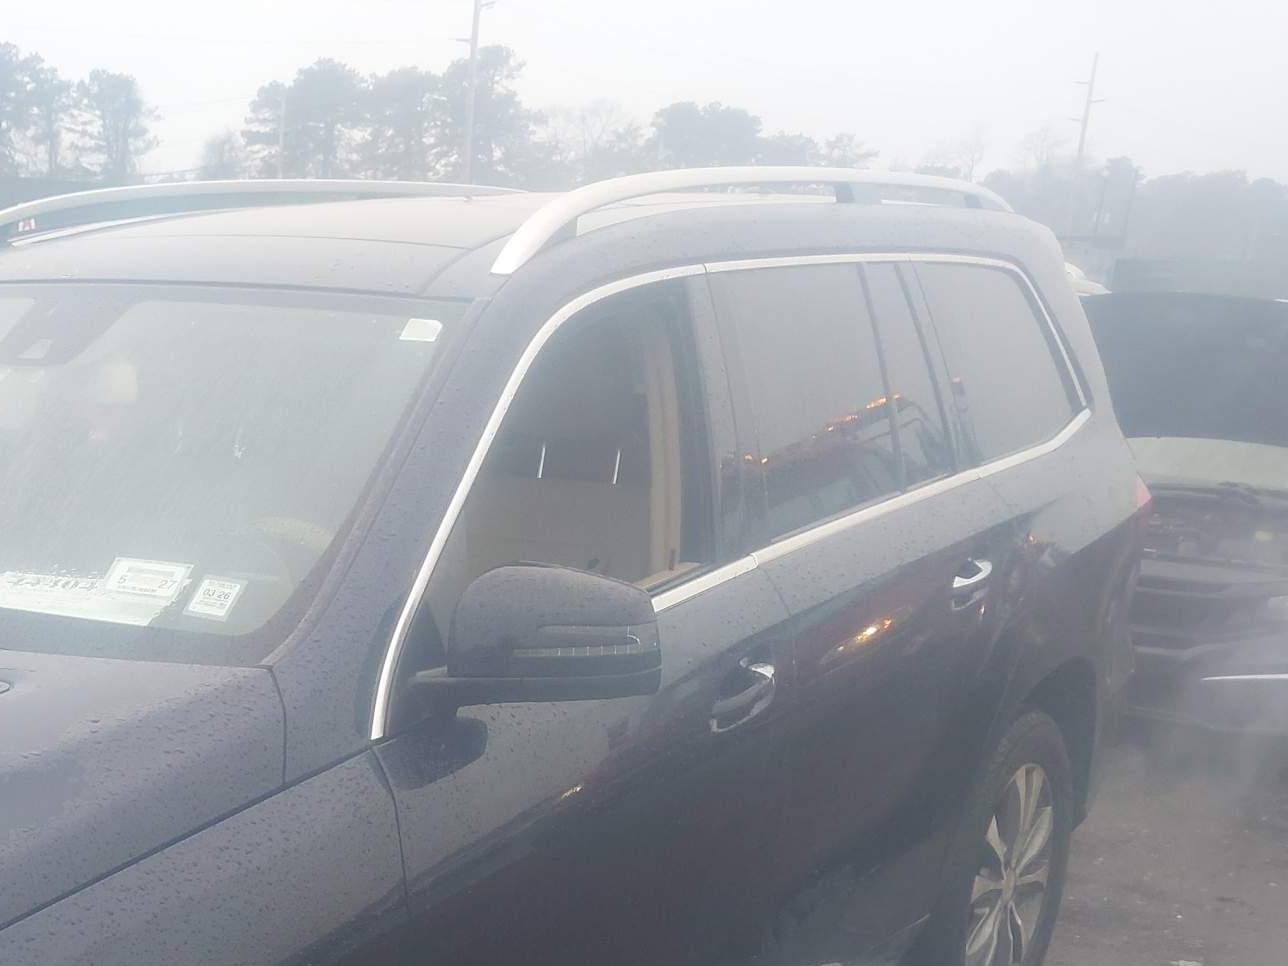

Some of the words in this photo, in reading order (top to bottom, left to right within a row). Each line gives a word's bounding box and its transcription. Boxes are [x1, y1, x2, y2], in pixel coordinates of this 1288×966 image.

[116, 574, 129, 585] 5
[157, 579, 178, 590] 27
[201, 587, 217, 598] 03
[216, 590, 232, 600] 26
